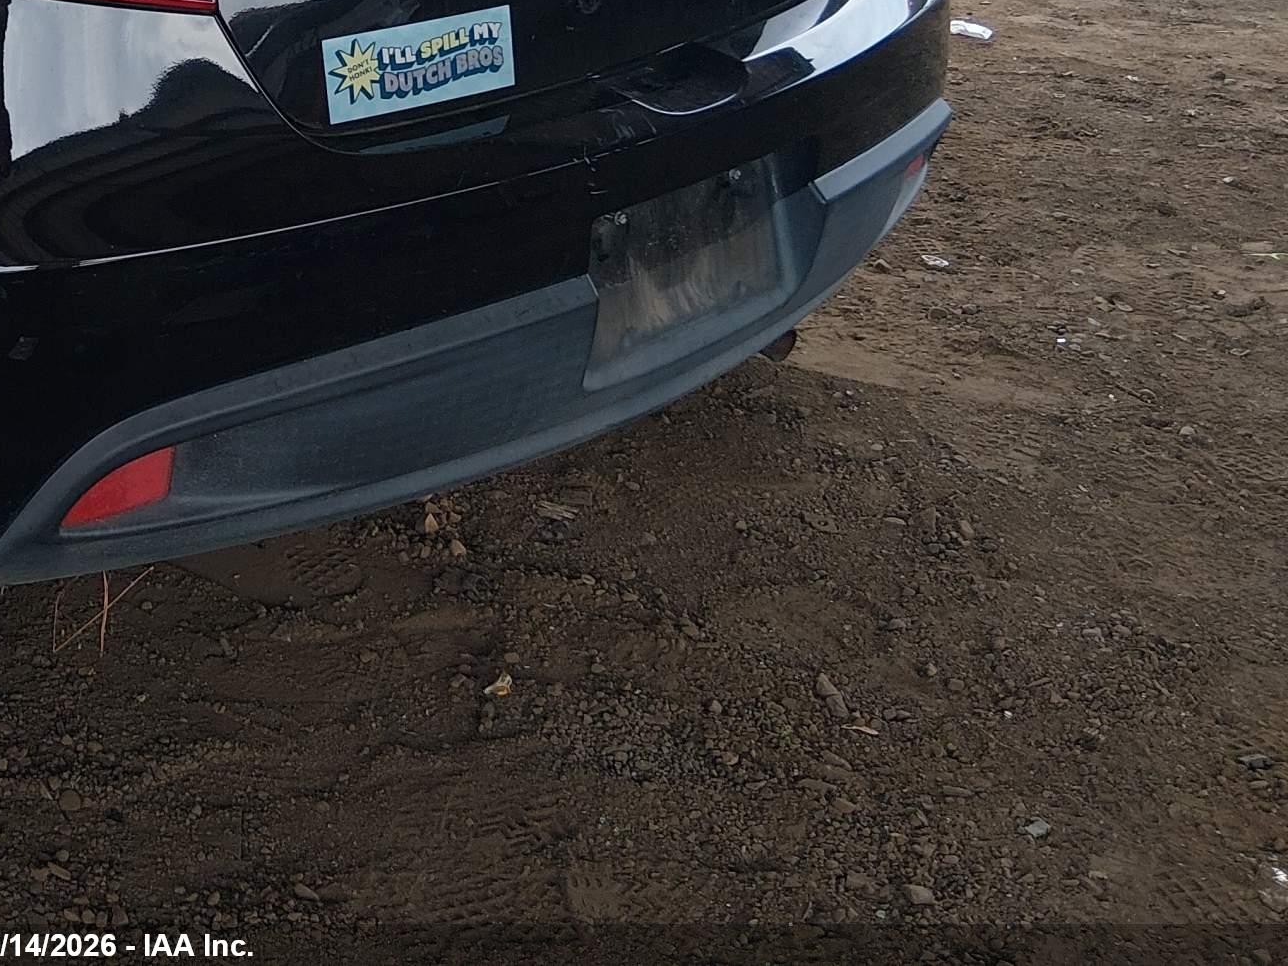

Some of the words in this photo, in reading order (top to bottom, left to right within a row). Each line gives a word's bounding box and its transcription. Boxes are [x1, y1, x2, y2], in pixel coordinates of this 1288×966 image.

[347, 59, 370, 74] DON'T
[379, 46, 416, 67] I'LL
[418, 27, 469, 59] SPILL
[470, 22, 502, 43] MY
[382, 57, 452, 96] DUTCH
[455, 45, 504, 75] BROS
